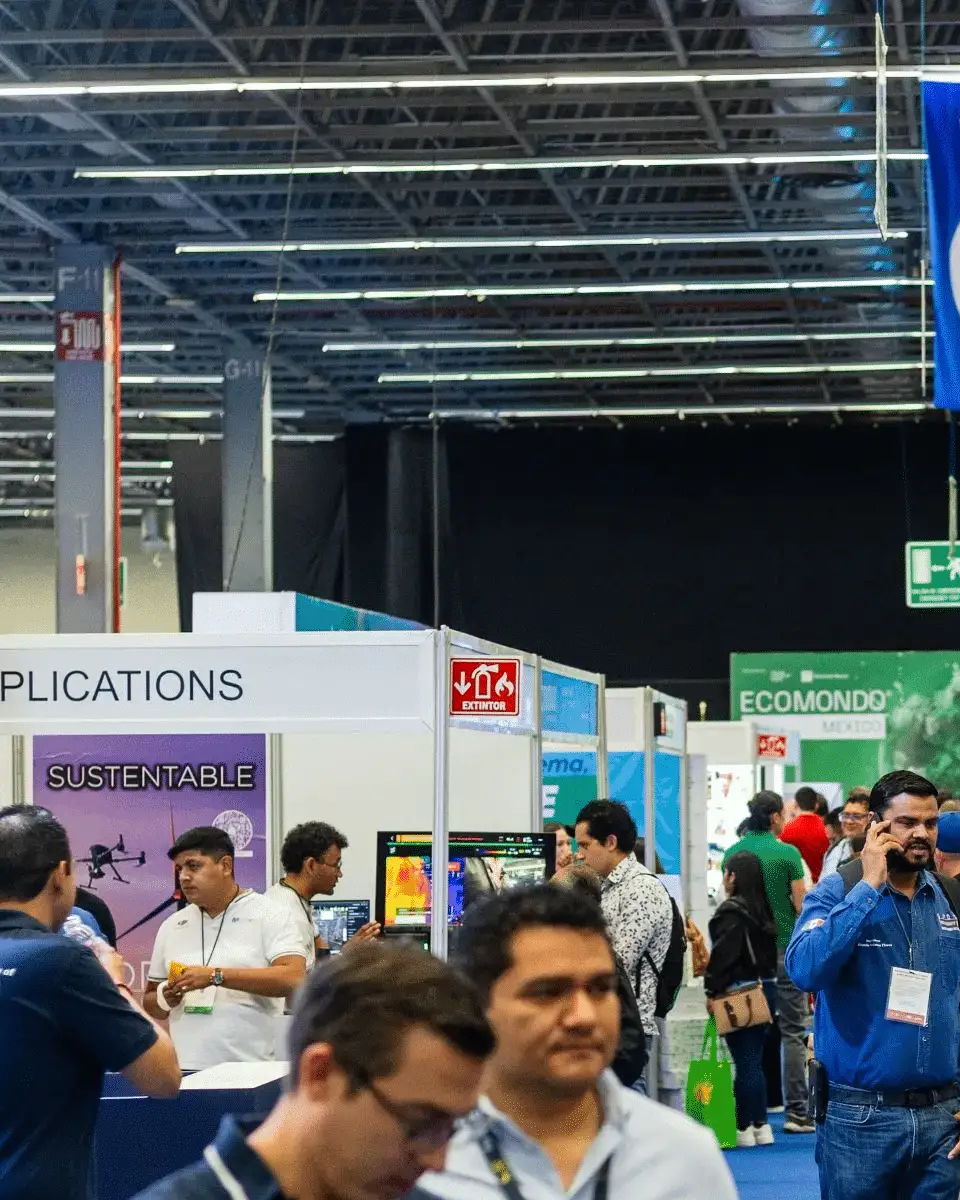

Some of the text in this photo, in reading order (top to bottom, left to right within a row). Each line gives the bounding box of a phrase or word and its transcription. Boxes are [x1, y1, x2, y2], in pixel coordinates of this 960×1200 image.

[462, 701, 506, 710] EXTINTOR
[739, 689, 886, 712] ECOMONDO
[48, 765, 253, 788] SUSTENTABLE
